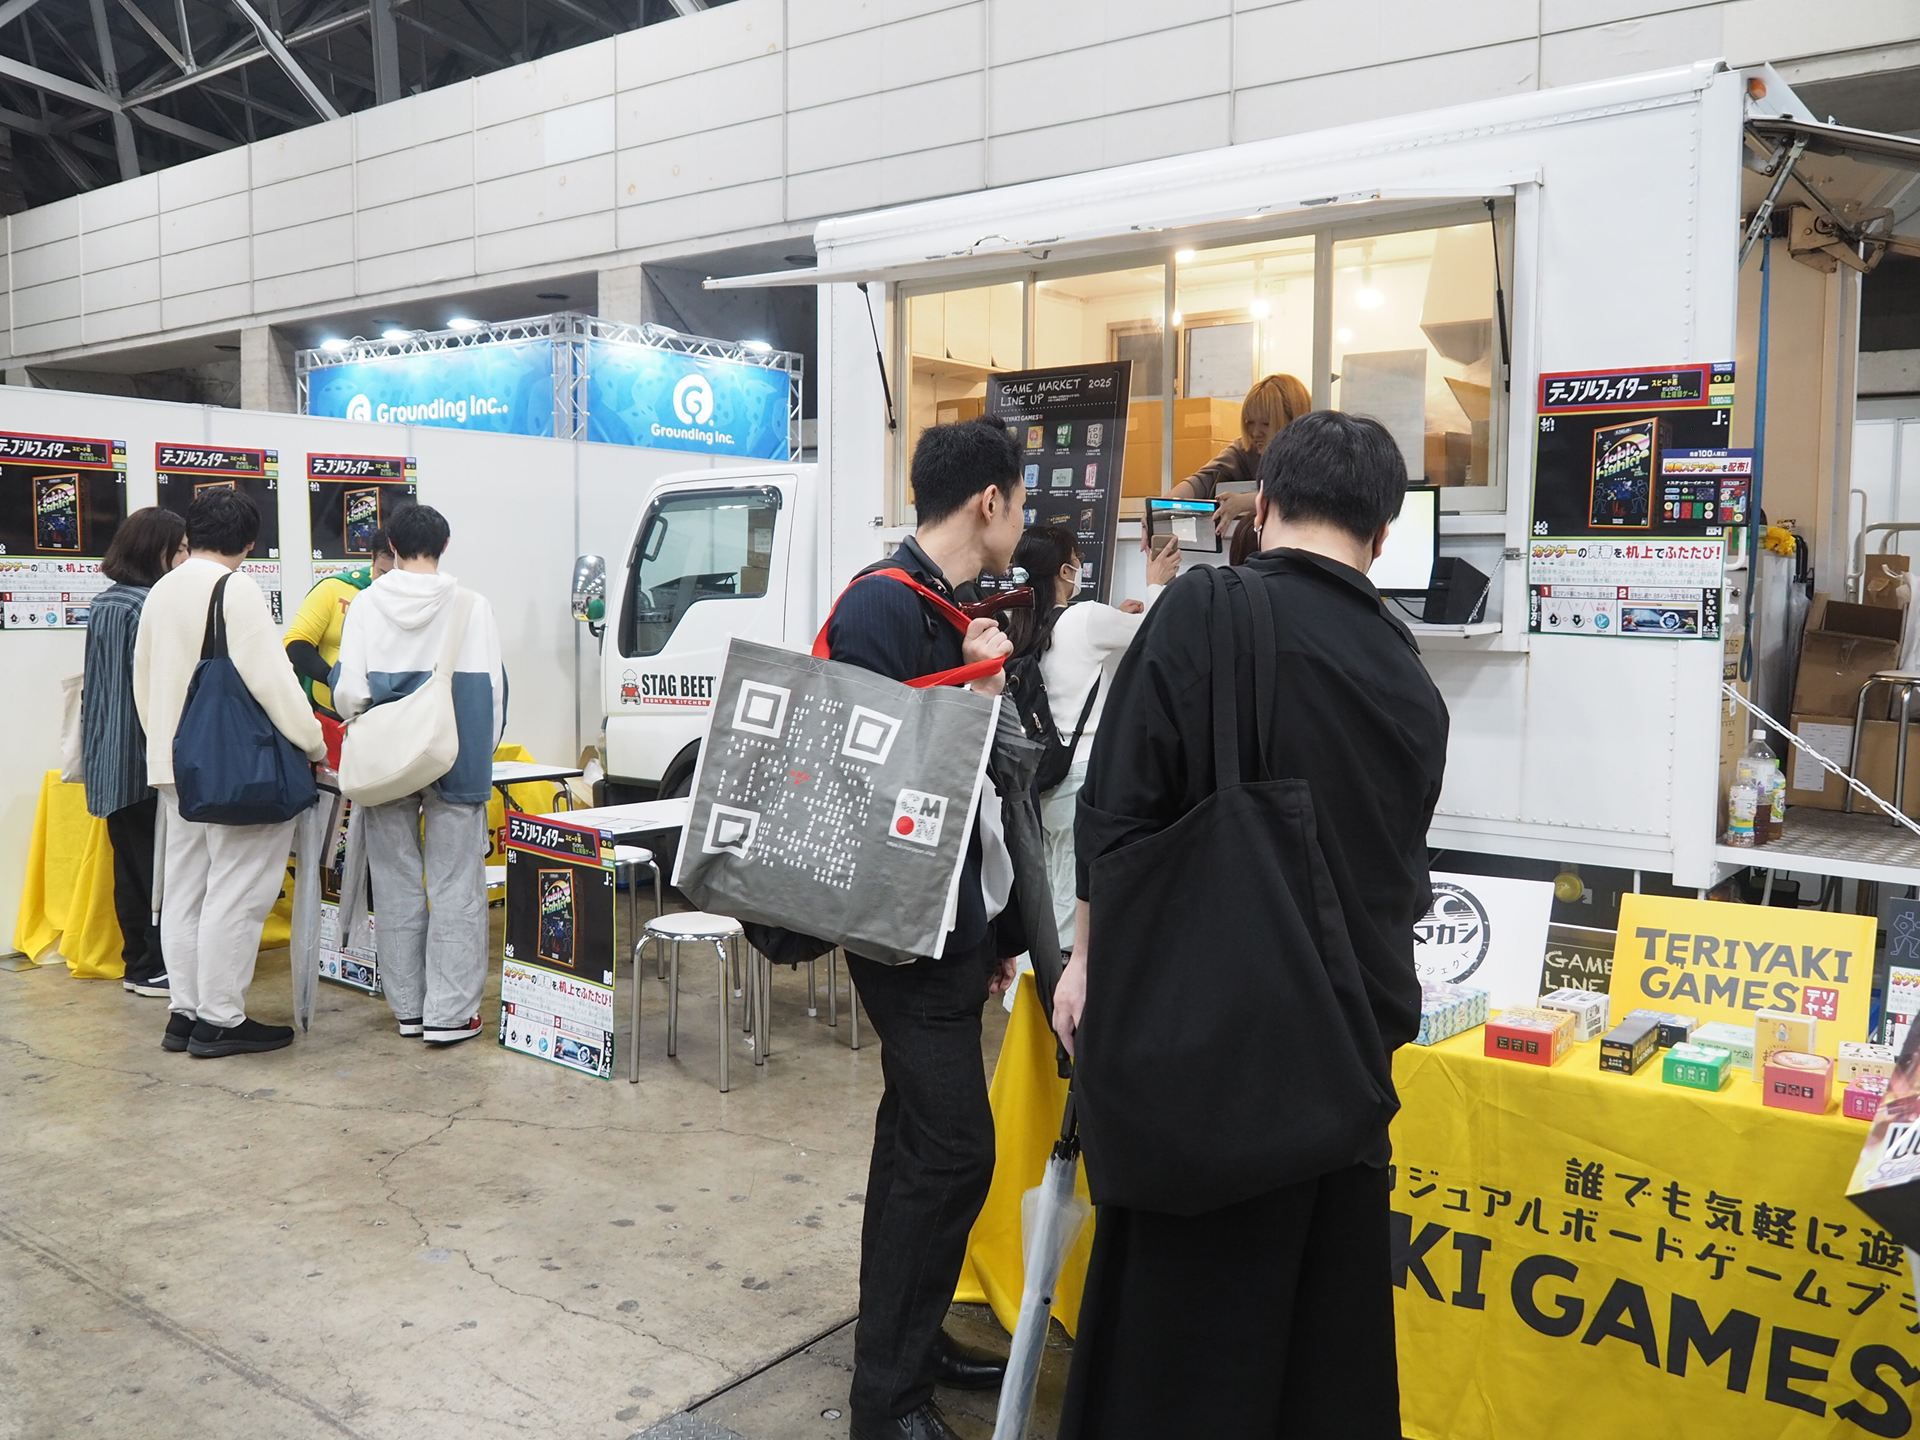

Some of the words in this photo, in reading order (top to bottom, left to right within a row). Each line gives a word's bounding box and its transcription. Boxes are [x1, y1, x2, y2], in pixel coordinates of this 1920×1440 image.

[1001, 382, 1034, 396] GAME
[1037, 378, 1082, 392] MARKET
[1548, 377, 1649, 403] テーブルファイター
[376, 398, 467, 424] Grounding
[1000, 394, 1026, 407] LINE
[1030, 393, 1045, 405] UP
[650, 423, 714, 446] Grounding
[715, 430, 735, 445] Inc.
[0, 438, 72, 458] テーブルファイター
[161, 449, 229, 467] テーブルファイター
[313, 459, 375, 475] テーブルファイター
[1618, 588, 1628, 599] 2
[641, 673, 677, 697] STAG
[680, 674, 717, 698] BEET
[675, 698, 708, 706] KITCHEN
[920, 797, 942, 819] M
[511, 819, 565, 848] テーブルファイター
[1545, 950, 1615, 976] GAME
[1635, 926, 1853, 984] TERIYAKI
[1639, 965, 1800, 1014] GAMES
[1806, 989, 1836, 1005] テリ
[1564, 1156, 1905, 1277] 誰でも気軽に遊
[1510, 1254, 1920, 1440] GAMES
